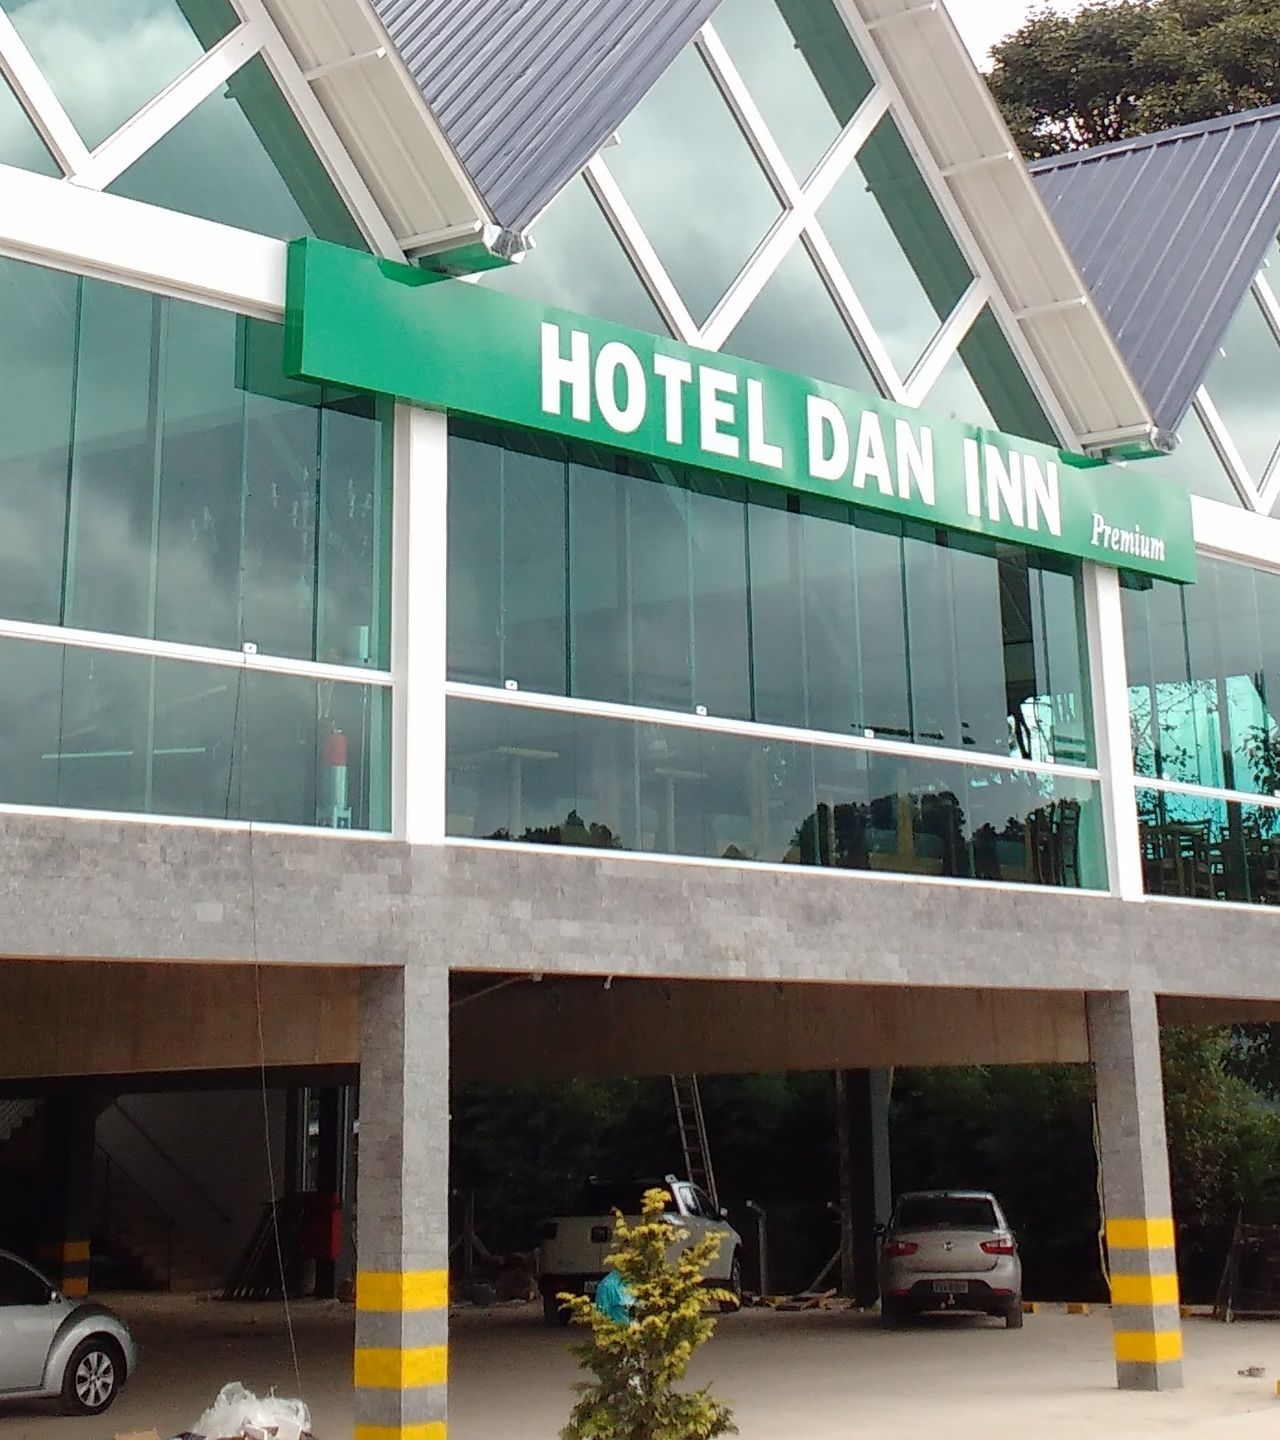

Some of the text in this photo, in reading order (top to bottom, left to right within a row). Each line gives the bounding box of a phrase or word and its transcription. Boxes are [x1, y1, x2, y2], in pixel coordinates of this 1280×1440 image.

[541, 321, 1062, 537] HOTEL DAN INN
[1090, 512, 1166, 561] Premium
